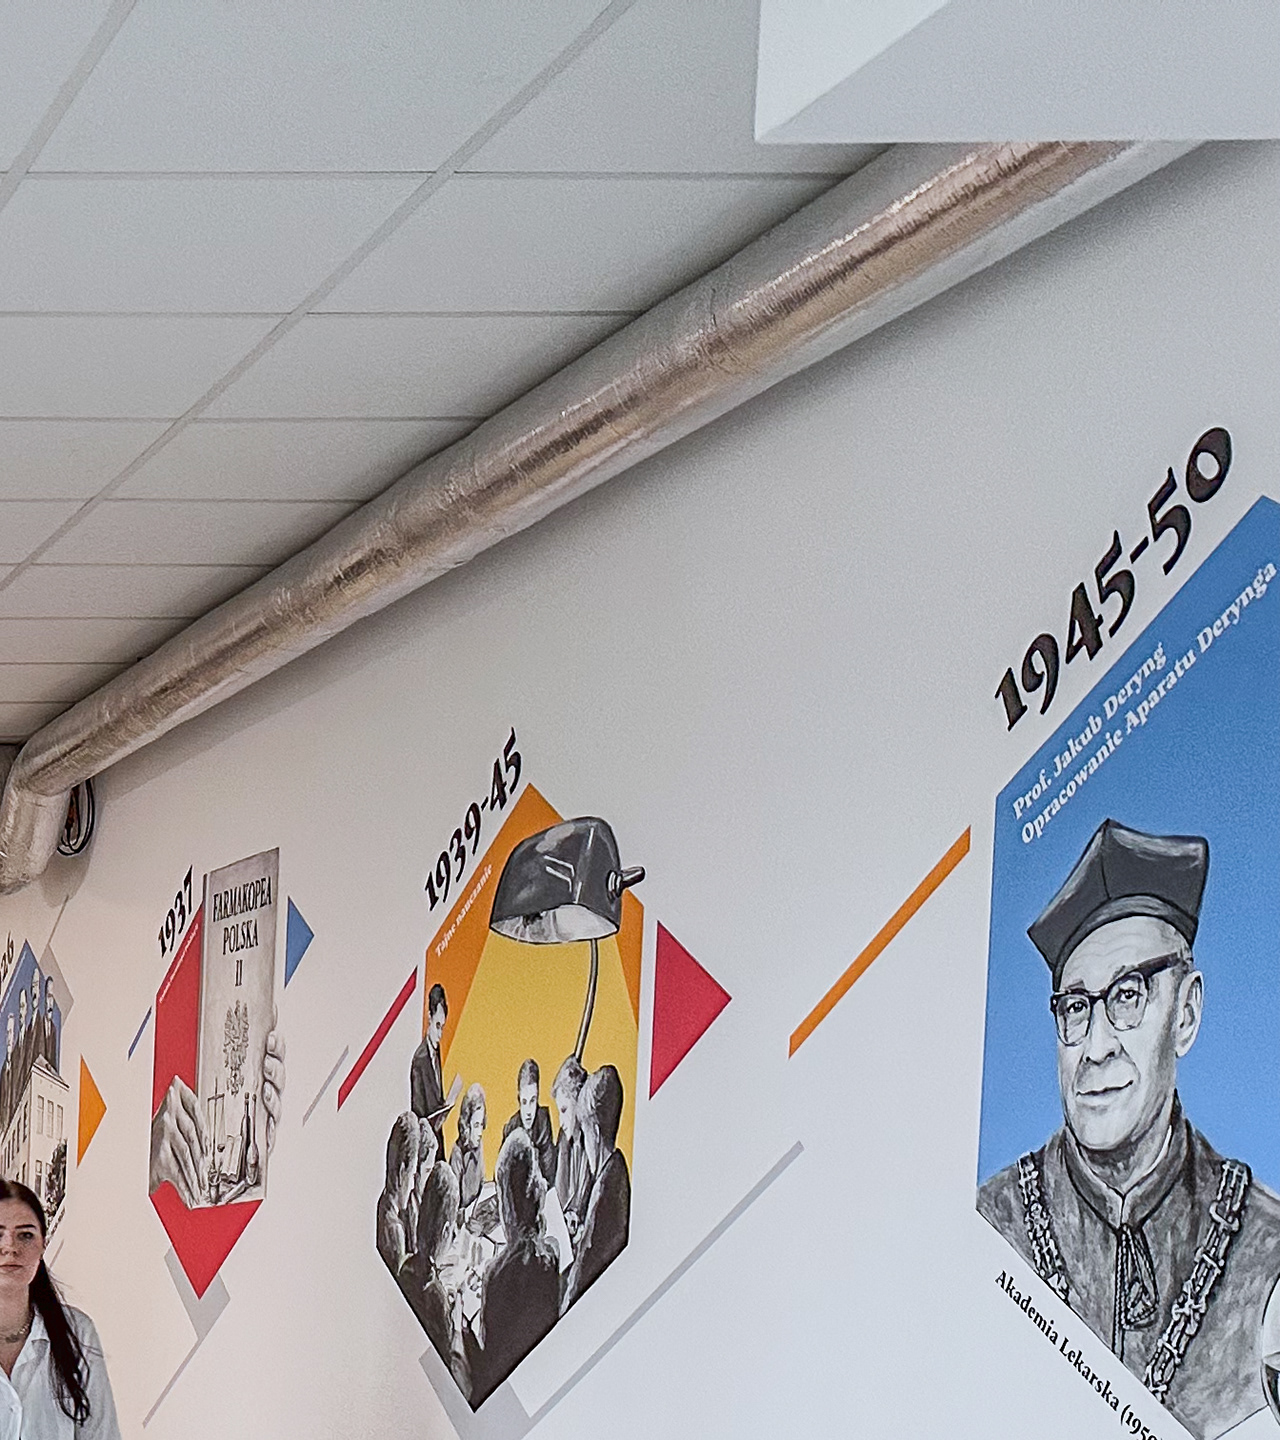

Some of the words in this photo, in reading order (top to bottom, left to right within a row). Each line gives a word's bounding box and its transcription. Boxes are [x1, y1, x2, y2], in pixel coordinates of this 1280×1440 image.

[995, 427, 1232, 731] 1945-50
[1012, 768, 1052, 819] Prof.
[1052, 715, 1102, 778] Jakub
[1103, 641, 1167, 720] Deryng
[1021, 728, 1123, 844] Opracowanie
[1124, 649, 1197, 735] Aparatu
[1196, 563, 1277, 653] Derynga
[425, 727, 522, 911] 1939-45
[158, 864, 192, 958] 1937
[213, 876, 272, 922] FARMAKOPEA
[223, 919, 258, 955] POLSKA
[454, 864, 492, 926] nauczanie
[235, 959, 243, 987] II
[994, 1270, 1059, 1346] Akademia
[1059, 1337, 1120, 1412] Lekarska
